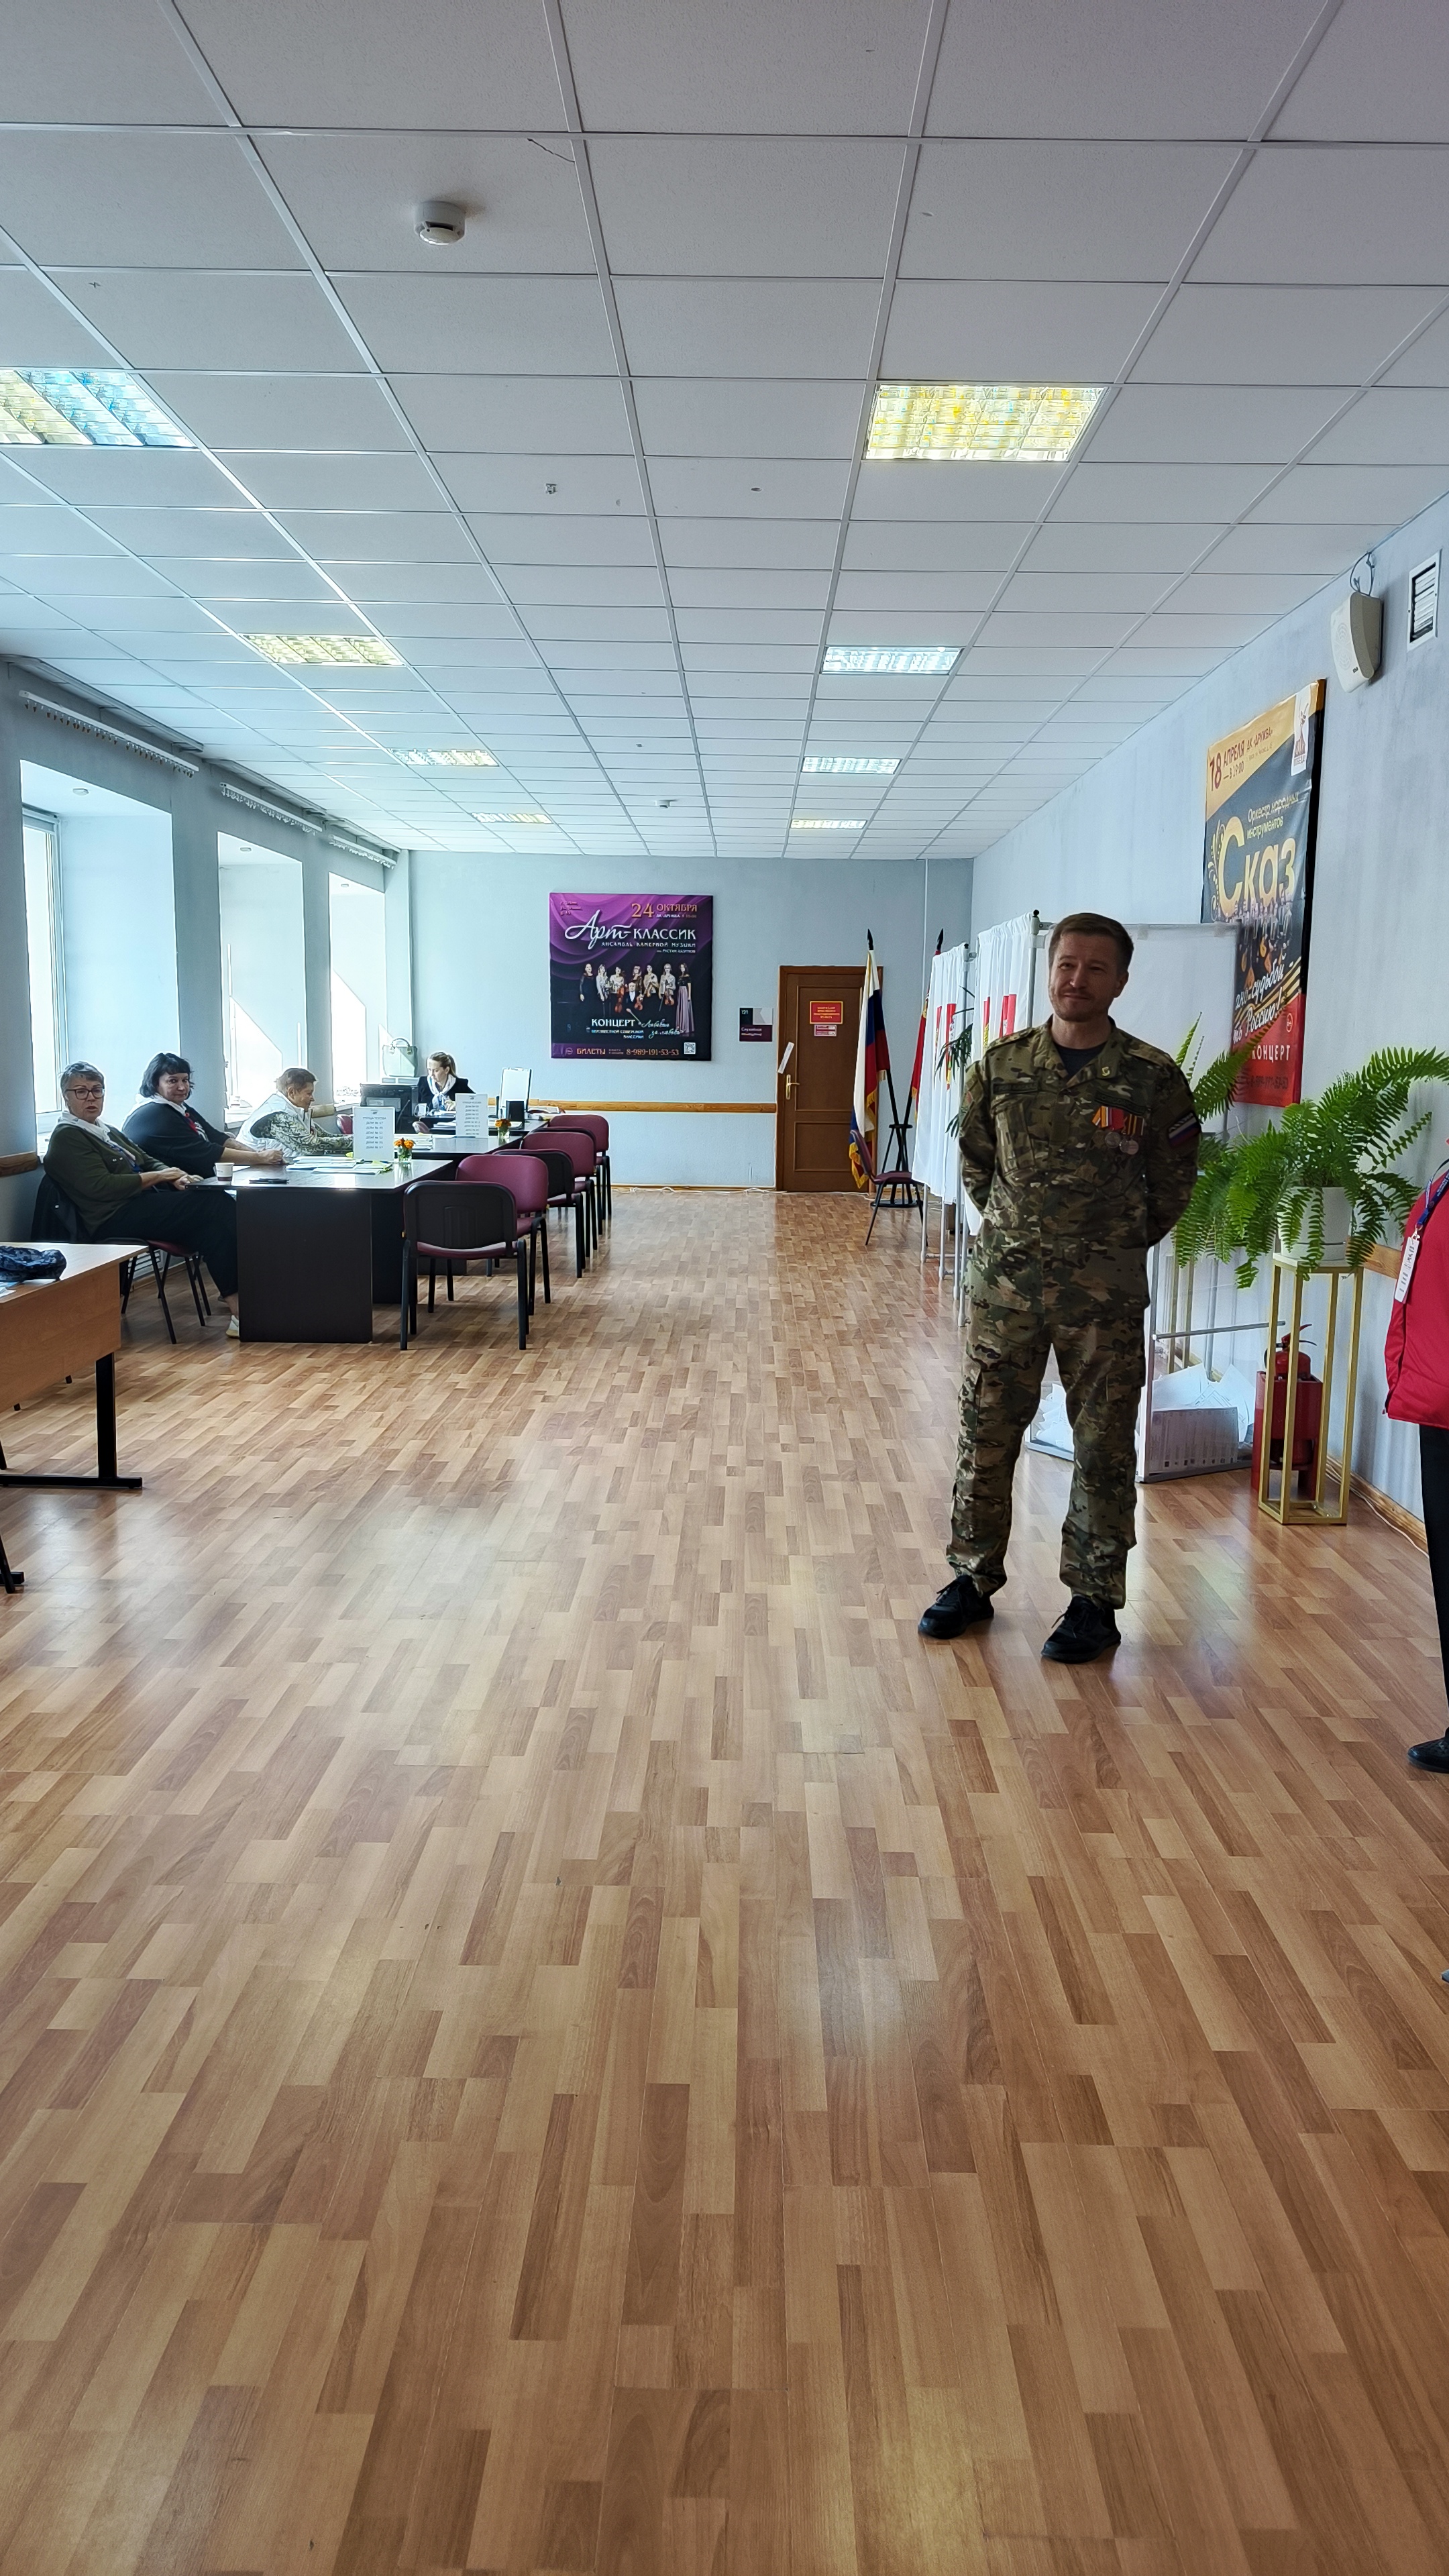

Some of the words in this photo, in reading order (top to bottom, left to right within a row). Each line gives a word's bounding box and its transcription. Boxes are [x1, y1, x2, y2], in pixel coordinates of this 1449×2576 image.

[1210, 753, 1222, 792] 18
[1224, 739, 1245, 767] АПРЕЛЯ
[1248, 804, 1271, 825] Оркестр
[1271, 791, 1299, 815] народных
[1246, 816, 1284, 839] инструментов
[1218, 816, 1296, 918] Сказ
[631, 903, 654, 918] 24
[657, 903, 697, 912] ОКТЯБРЯ
[591, 1018, 636, 1028] КОНЦЕРТ
[1252, 1044, 1291, 1063] КОНЦЕРТ
